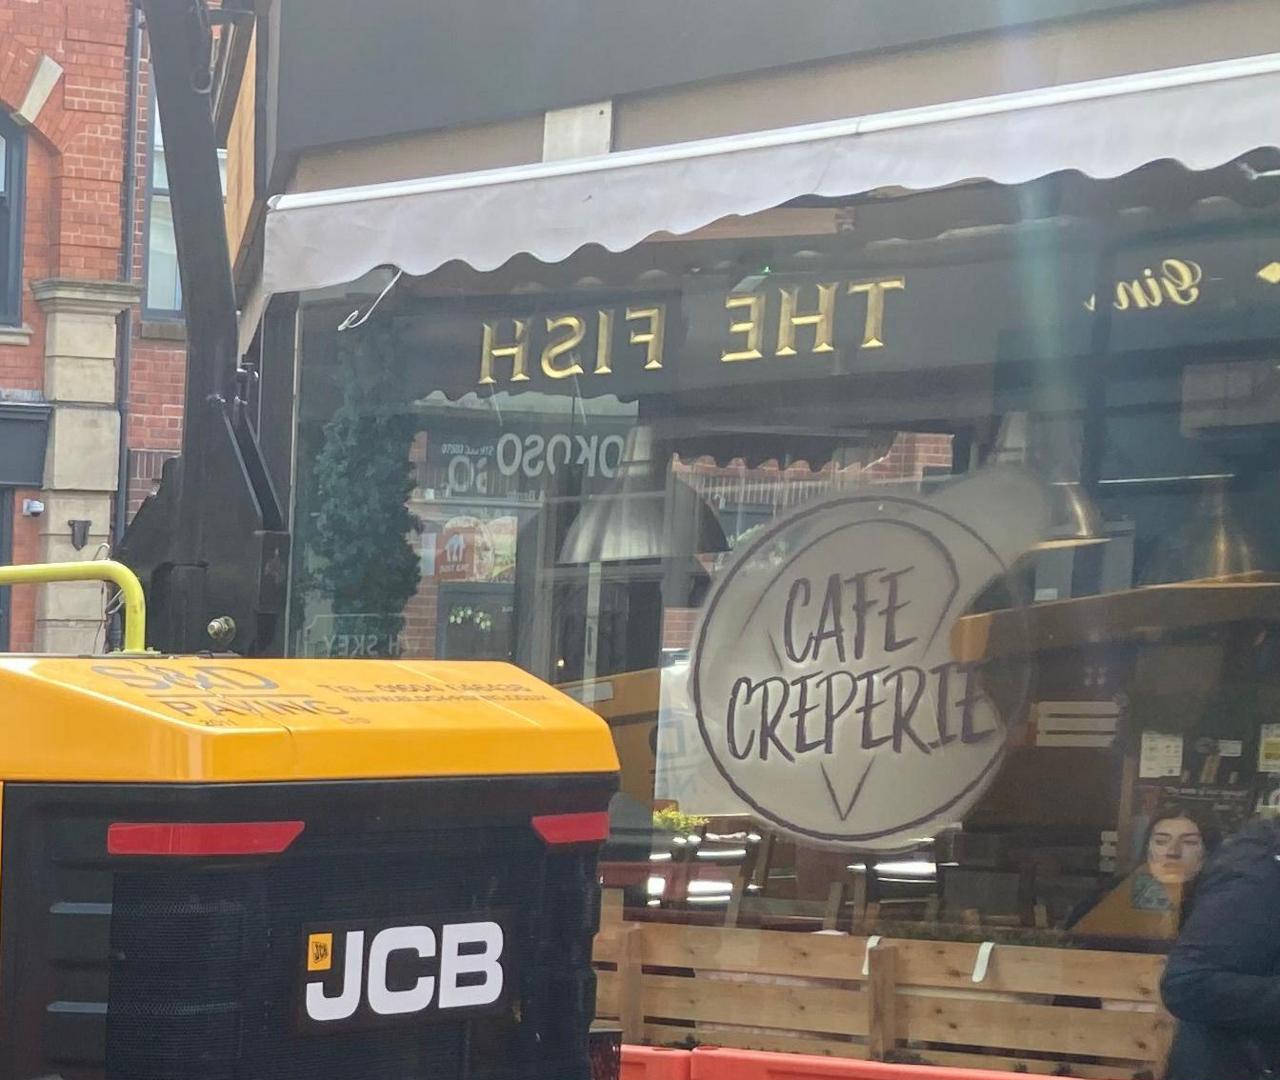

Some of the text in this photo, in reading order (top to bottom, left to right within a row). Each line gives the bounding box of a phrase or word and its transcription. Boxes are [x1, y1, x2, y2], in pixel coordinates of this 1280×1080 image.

[783, 566, 918, 664] CAFE
[158, 700, 351, 717] PAVING
[726, 661, 996, 763] CREPERIE
[306, 921, 505, 1021] JCB
